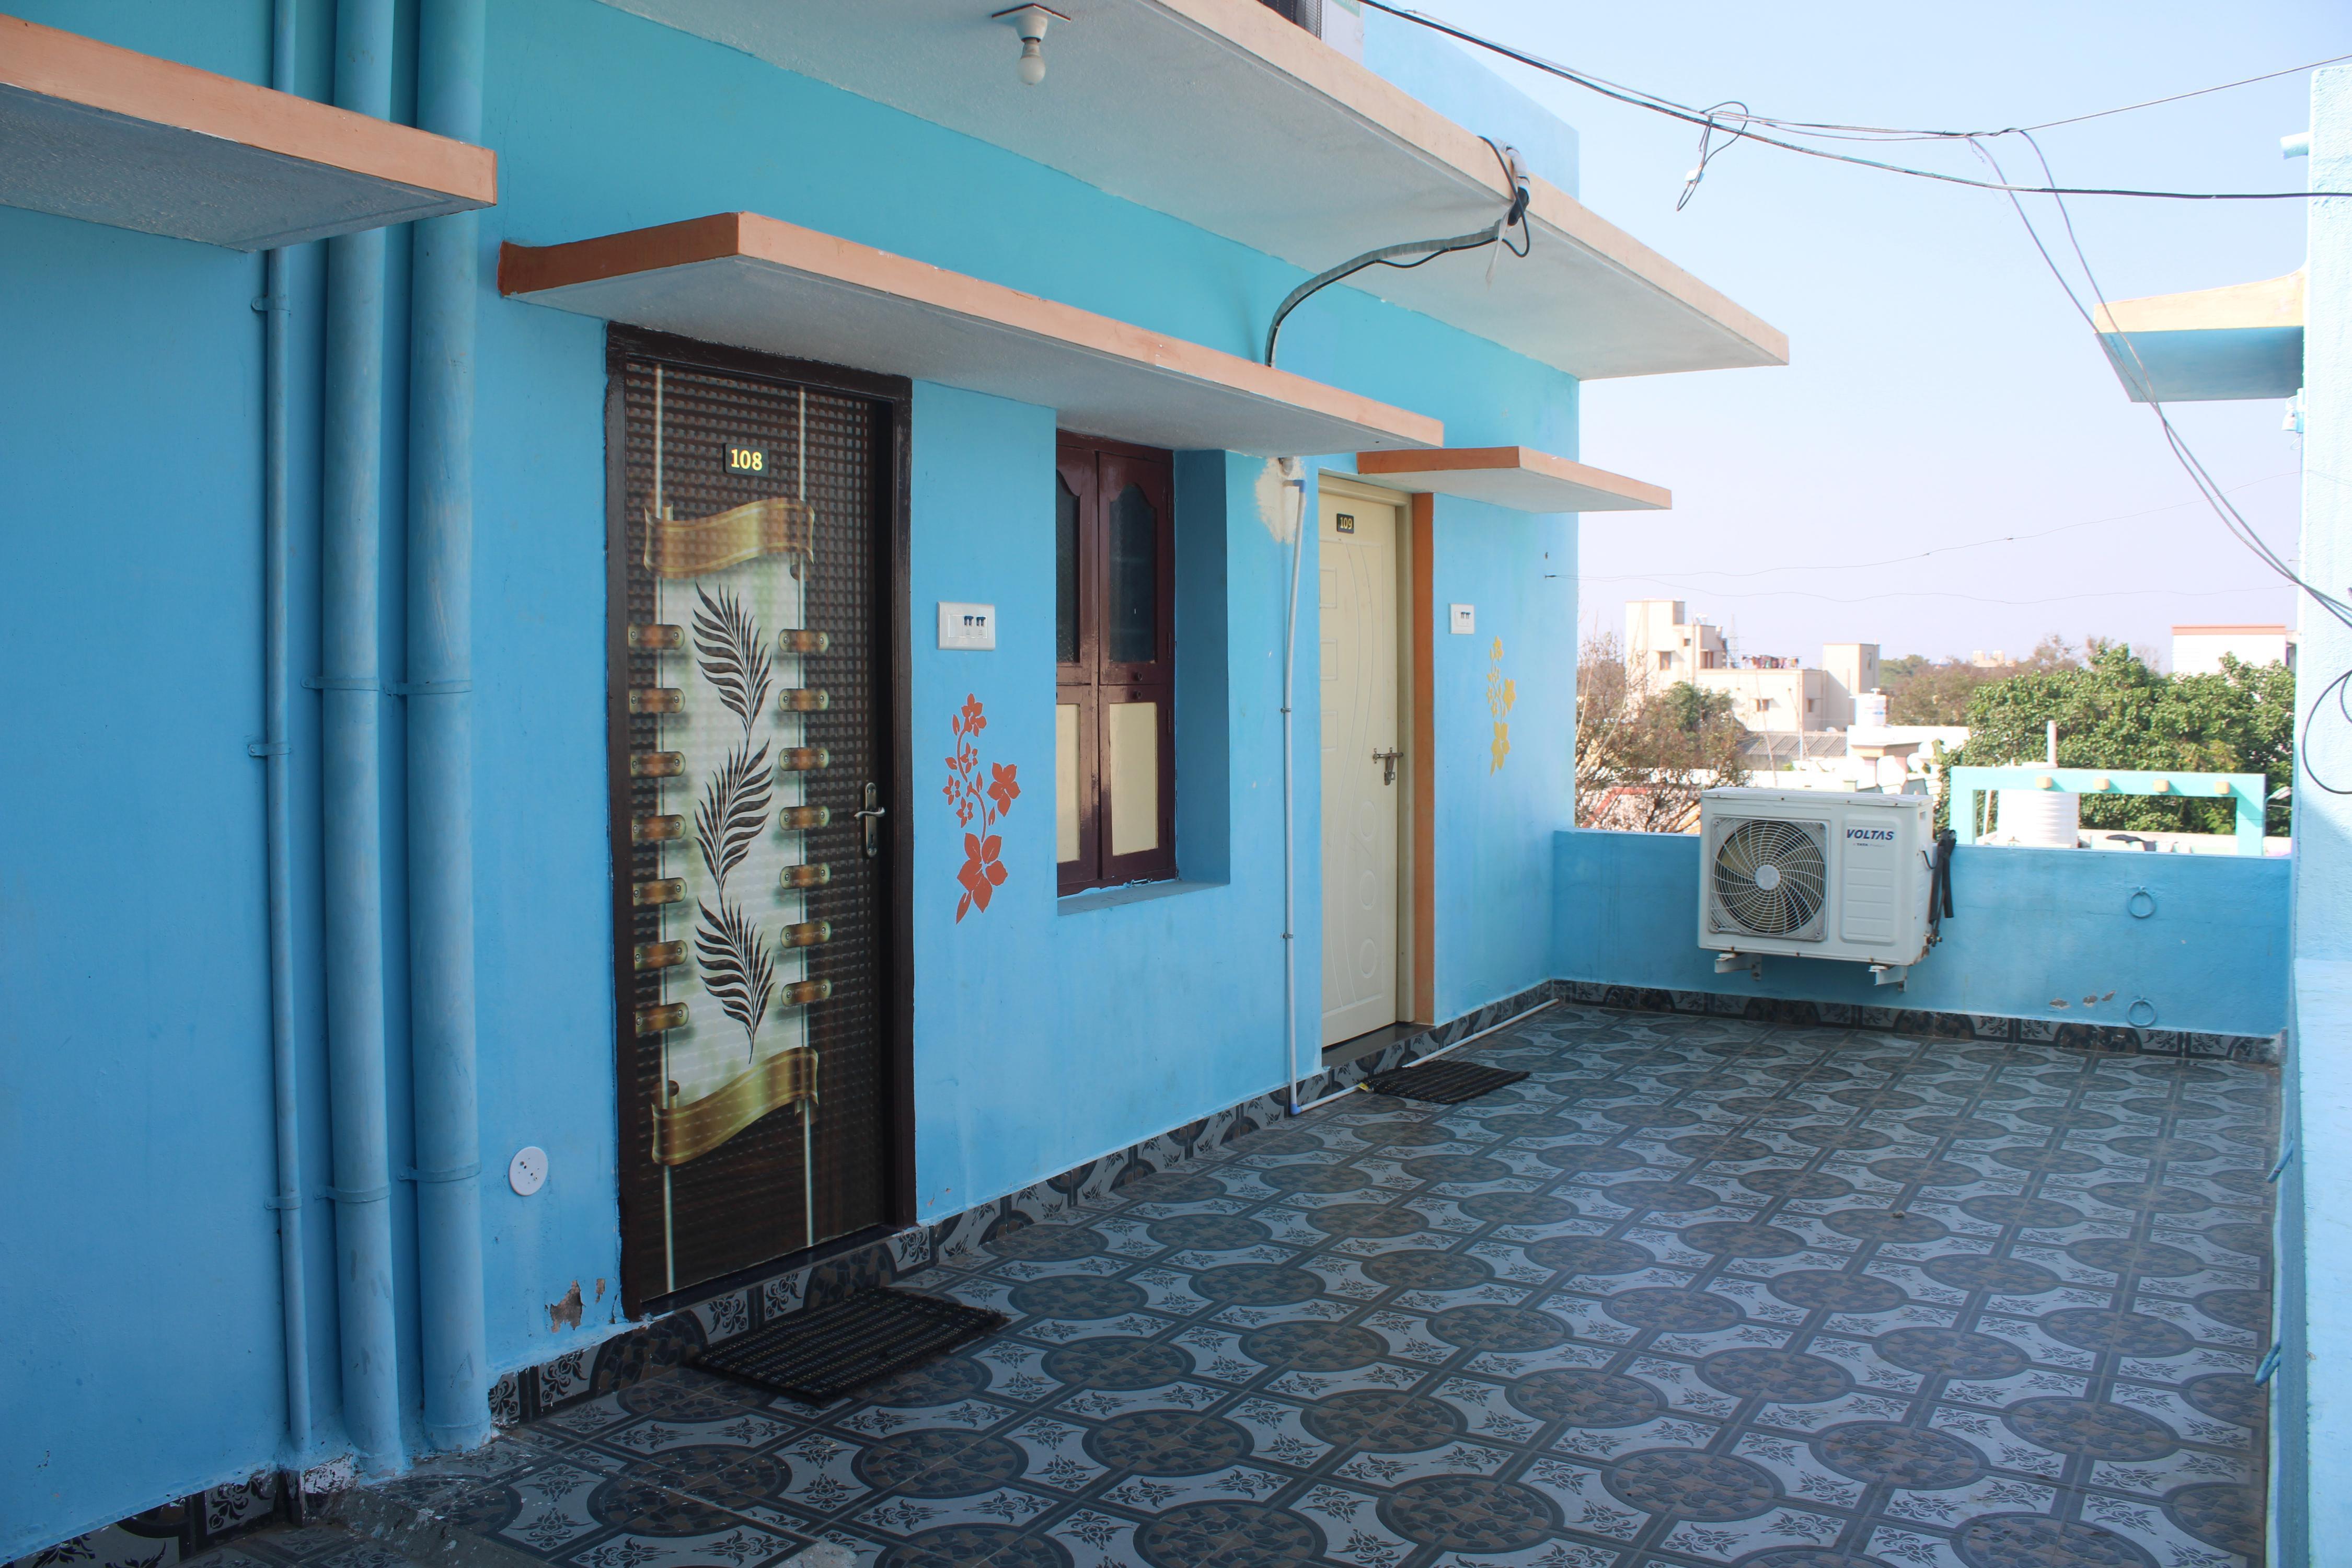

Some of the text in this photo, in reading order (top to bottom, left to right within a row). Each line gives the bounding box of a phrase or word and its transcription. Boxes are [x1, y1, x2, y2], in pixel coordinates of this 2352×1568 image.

[731, 448, 763, 471] 108
[1340, 517, 1352, 529] 109
[1846, 829, 1894, 840] VOLTAS
